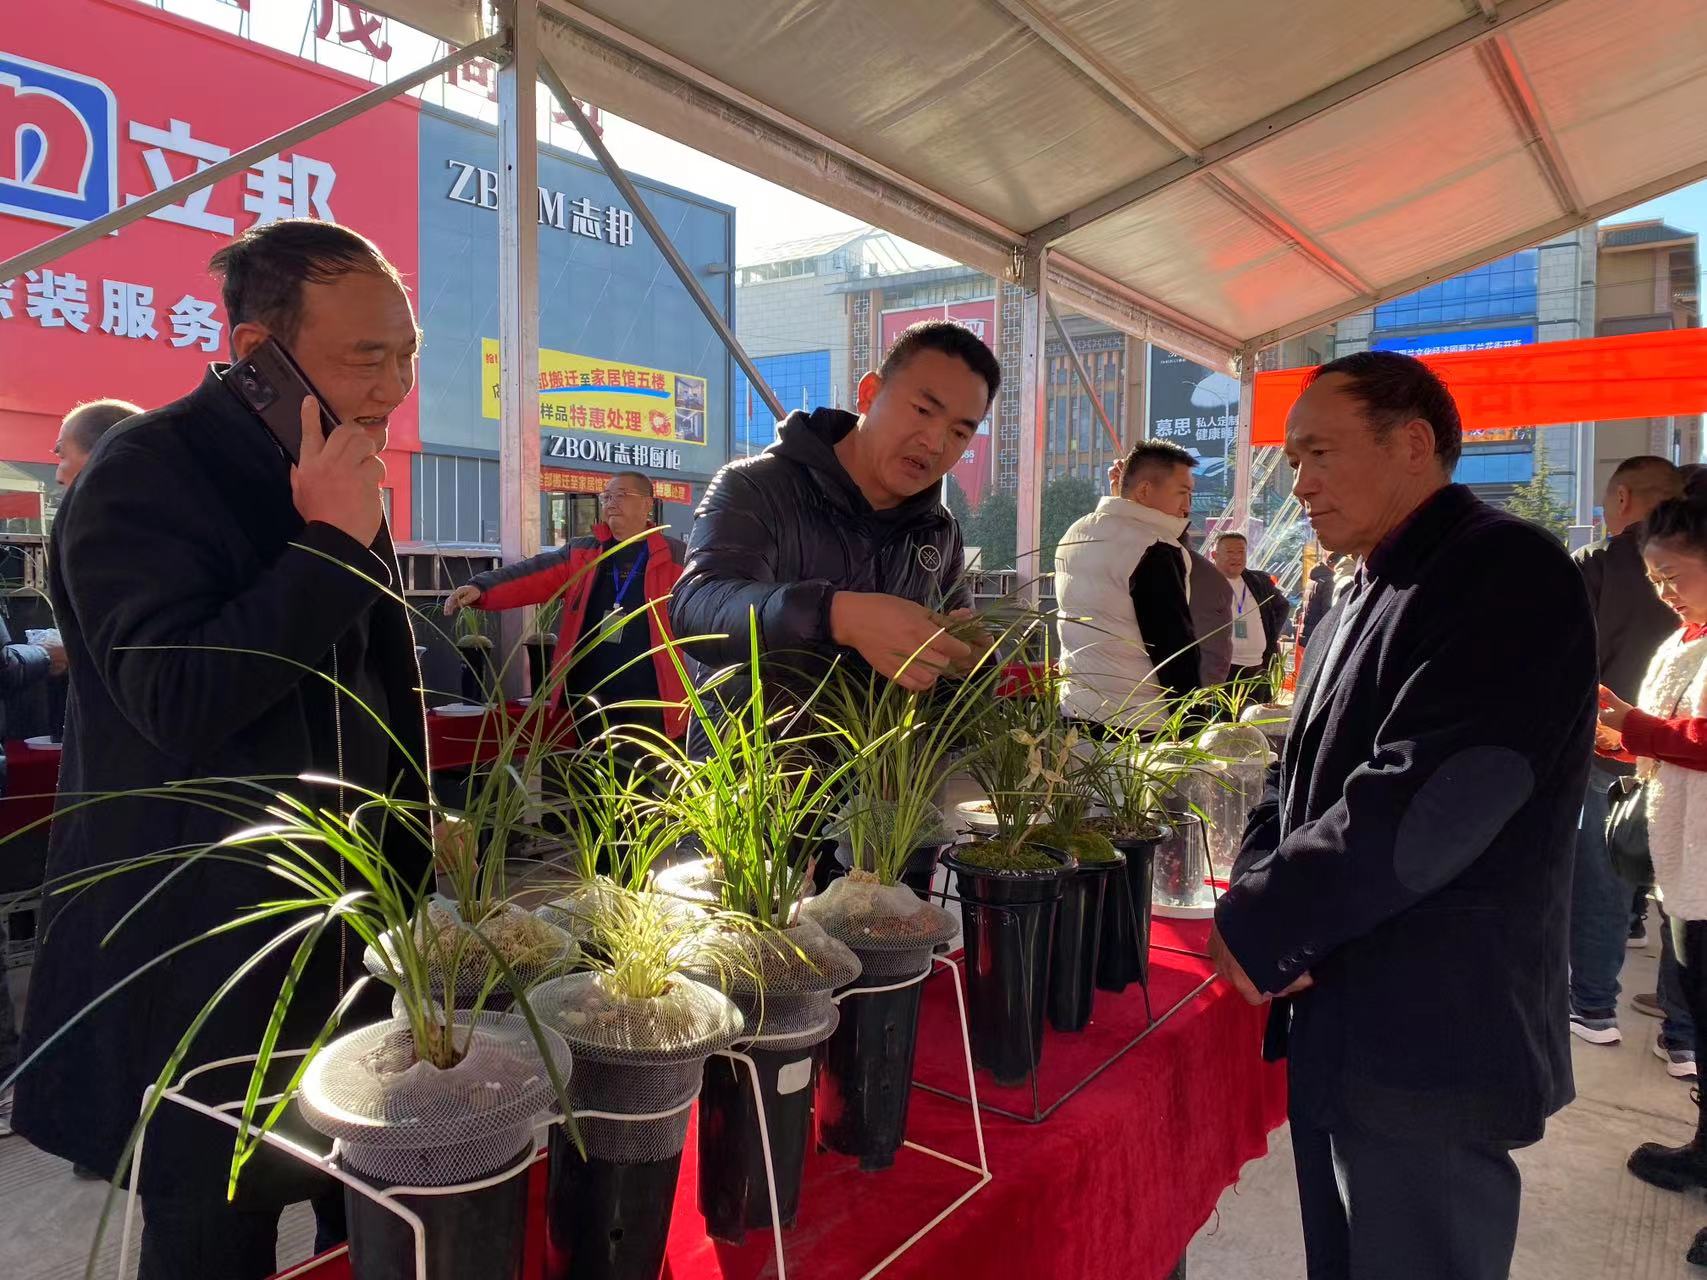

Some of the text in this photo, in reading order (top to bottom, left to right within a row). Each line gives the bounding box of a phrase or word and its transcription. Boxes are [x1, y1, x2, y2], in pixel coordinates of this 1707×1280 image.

[127, 118, 337, 237] 立邦
[447, 159, 634, 247] ZBM 志邦
[550, 435, 681, 470] ZBOM 志邦厨柜
[1155, 418, 1191, 437] 慕思
